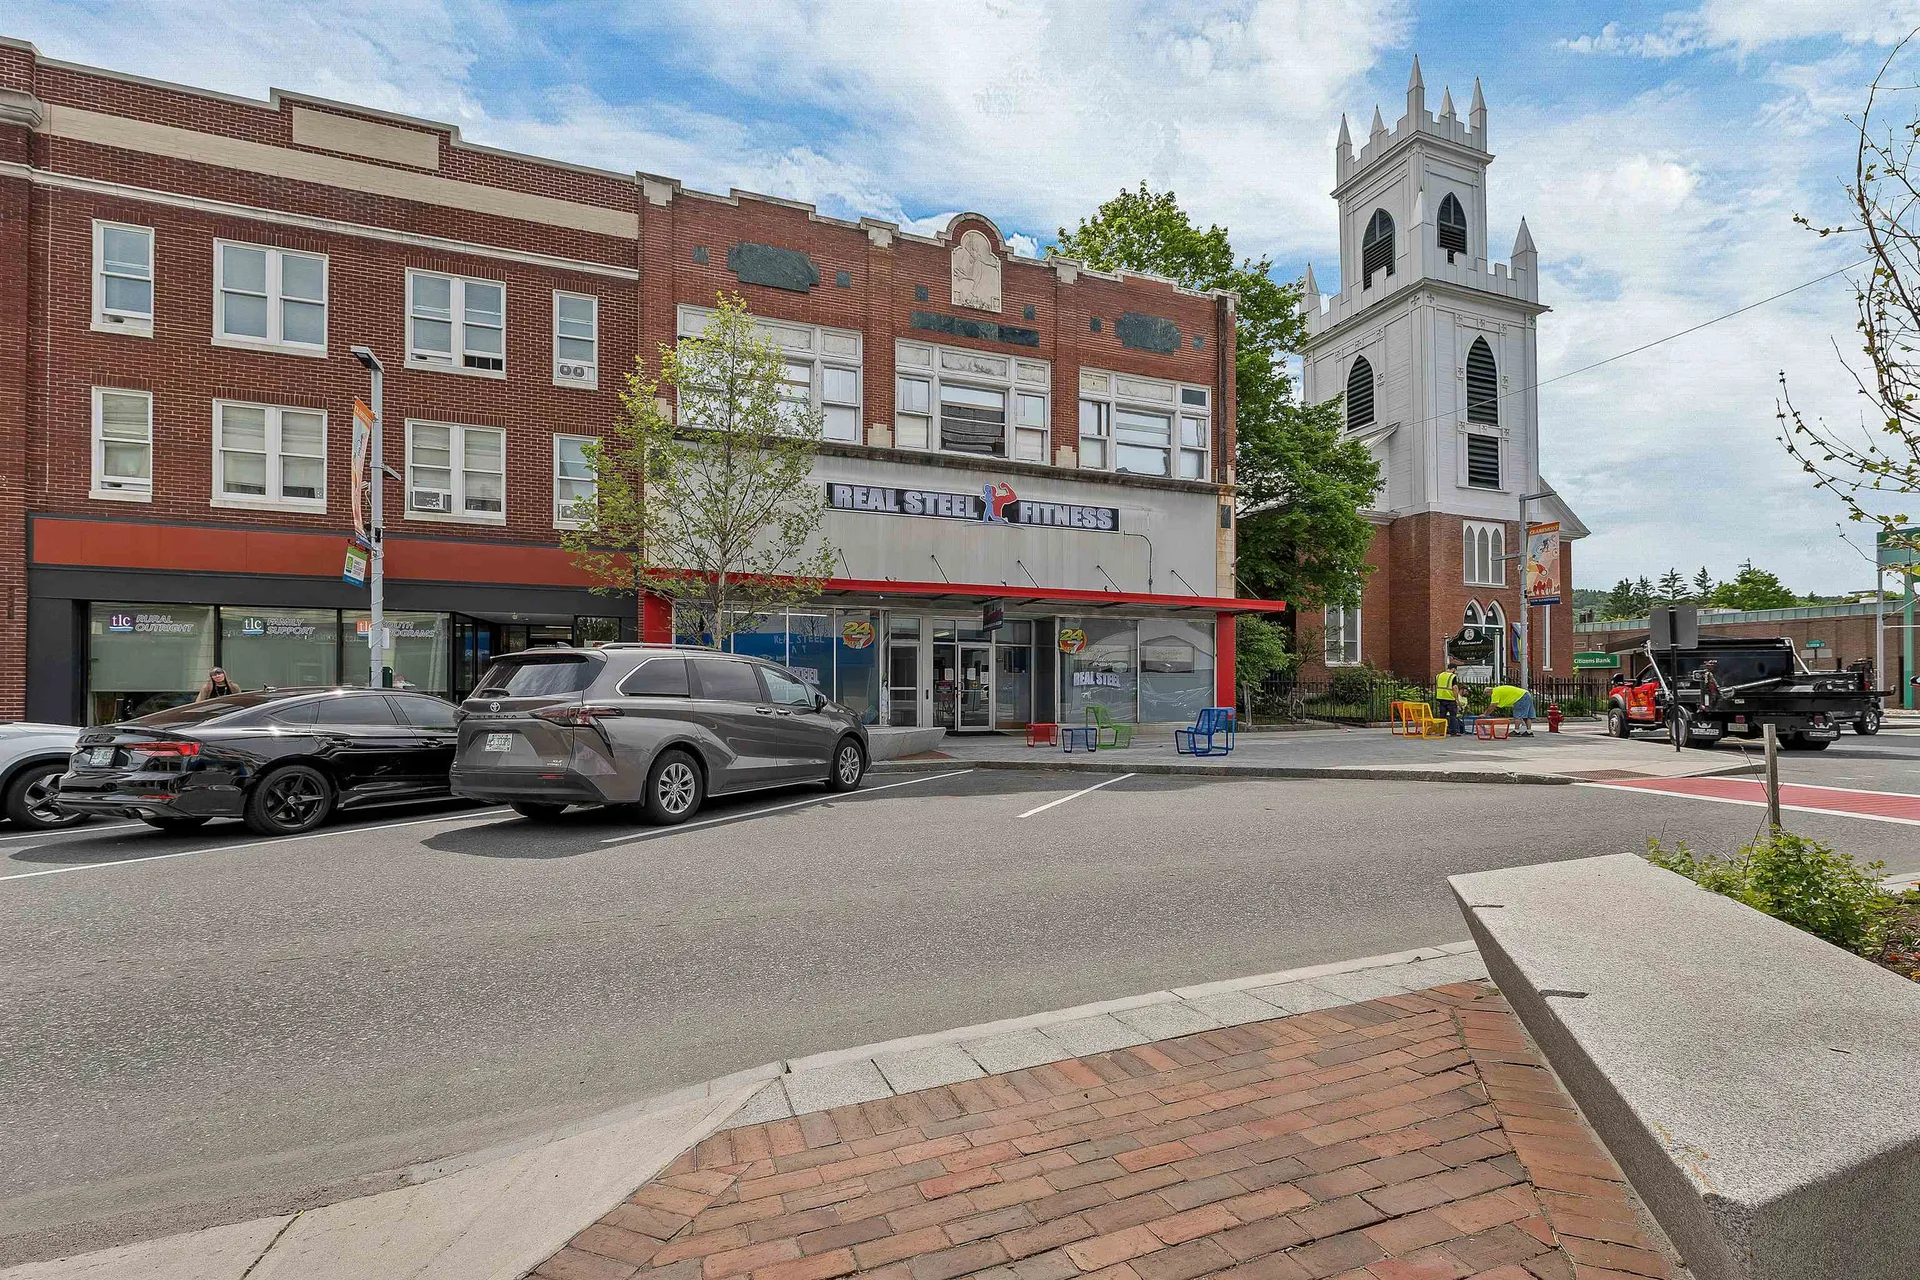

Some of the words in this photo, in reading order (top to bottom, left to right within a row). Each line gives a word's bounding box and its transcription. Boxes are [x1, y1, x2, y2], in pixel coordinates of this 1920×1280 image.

[834, 484, 900, 512] REAL
[903, 491, 979, 517] STEEL
[1020, 502, 1113, 530] FITNESS
[111, 614, 131, 626] tlc
[135, 614, 174, 623] RURAL
[245, 618, 262, 629] tlc
[266, 618, 304, 626] FAMILY
[135, 624, 194, 632] OUTRIGHT
[842, 621, 871, 635] 24
[1059, 629, 1083, 640] 24
[852, 634, 871, 649] 7
[1067, 640, 1083, 654] 7
[1073, 672, 1095, 687] REAL
[1096, 672, 1121, 687] STEEL
